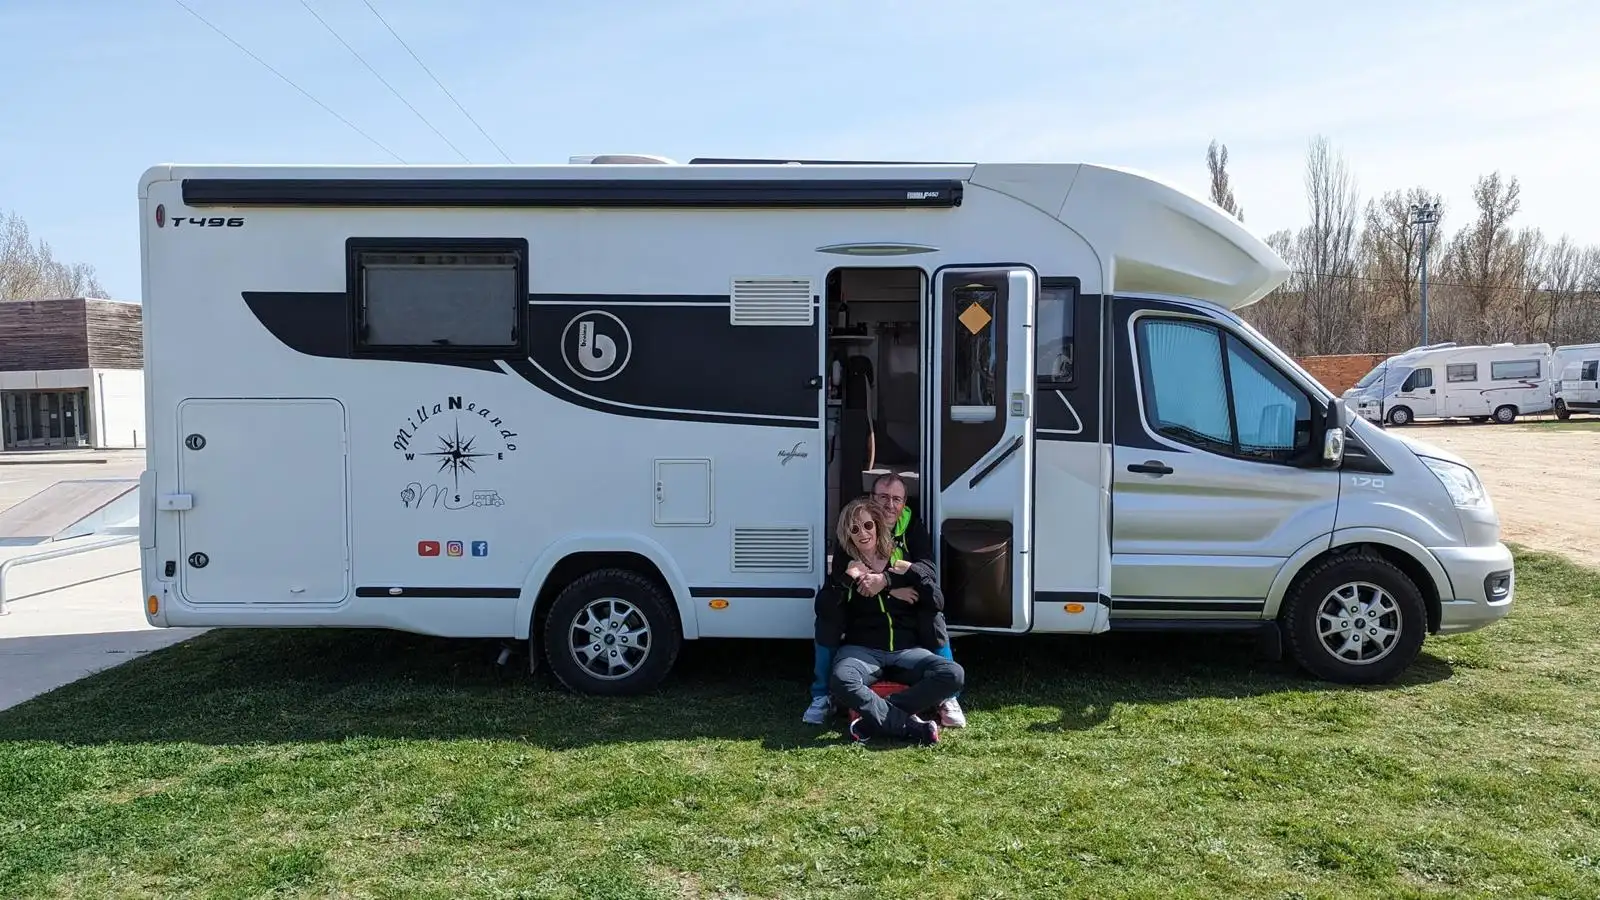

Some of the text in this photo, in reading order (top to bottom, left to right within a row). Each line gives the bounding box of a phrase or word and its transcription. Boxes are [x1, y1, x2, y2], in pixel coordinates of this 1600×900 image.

[171, 217, 245, 227] T496
[405, 453, 415, 461] W
[498, 452, 504, 461] E
[1351, 477, 1384, 488] 170
[454, 494, 461, 502] S
